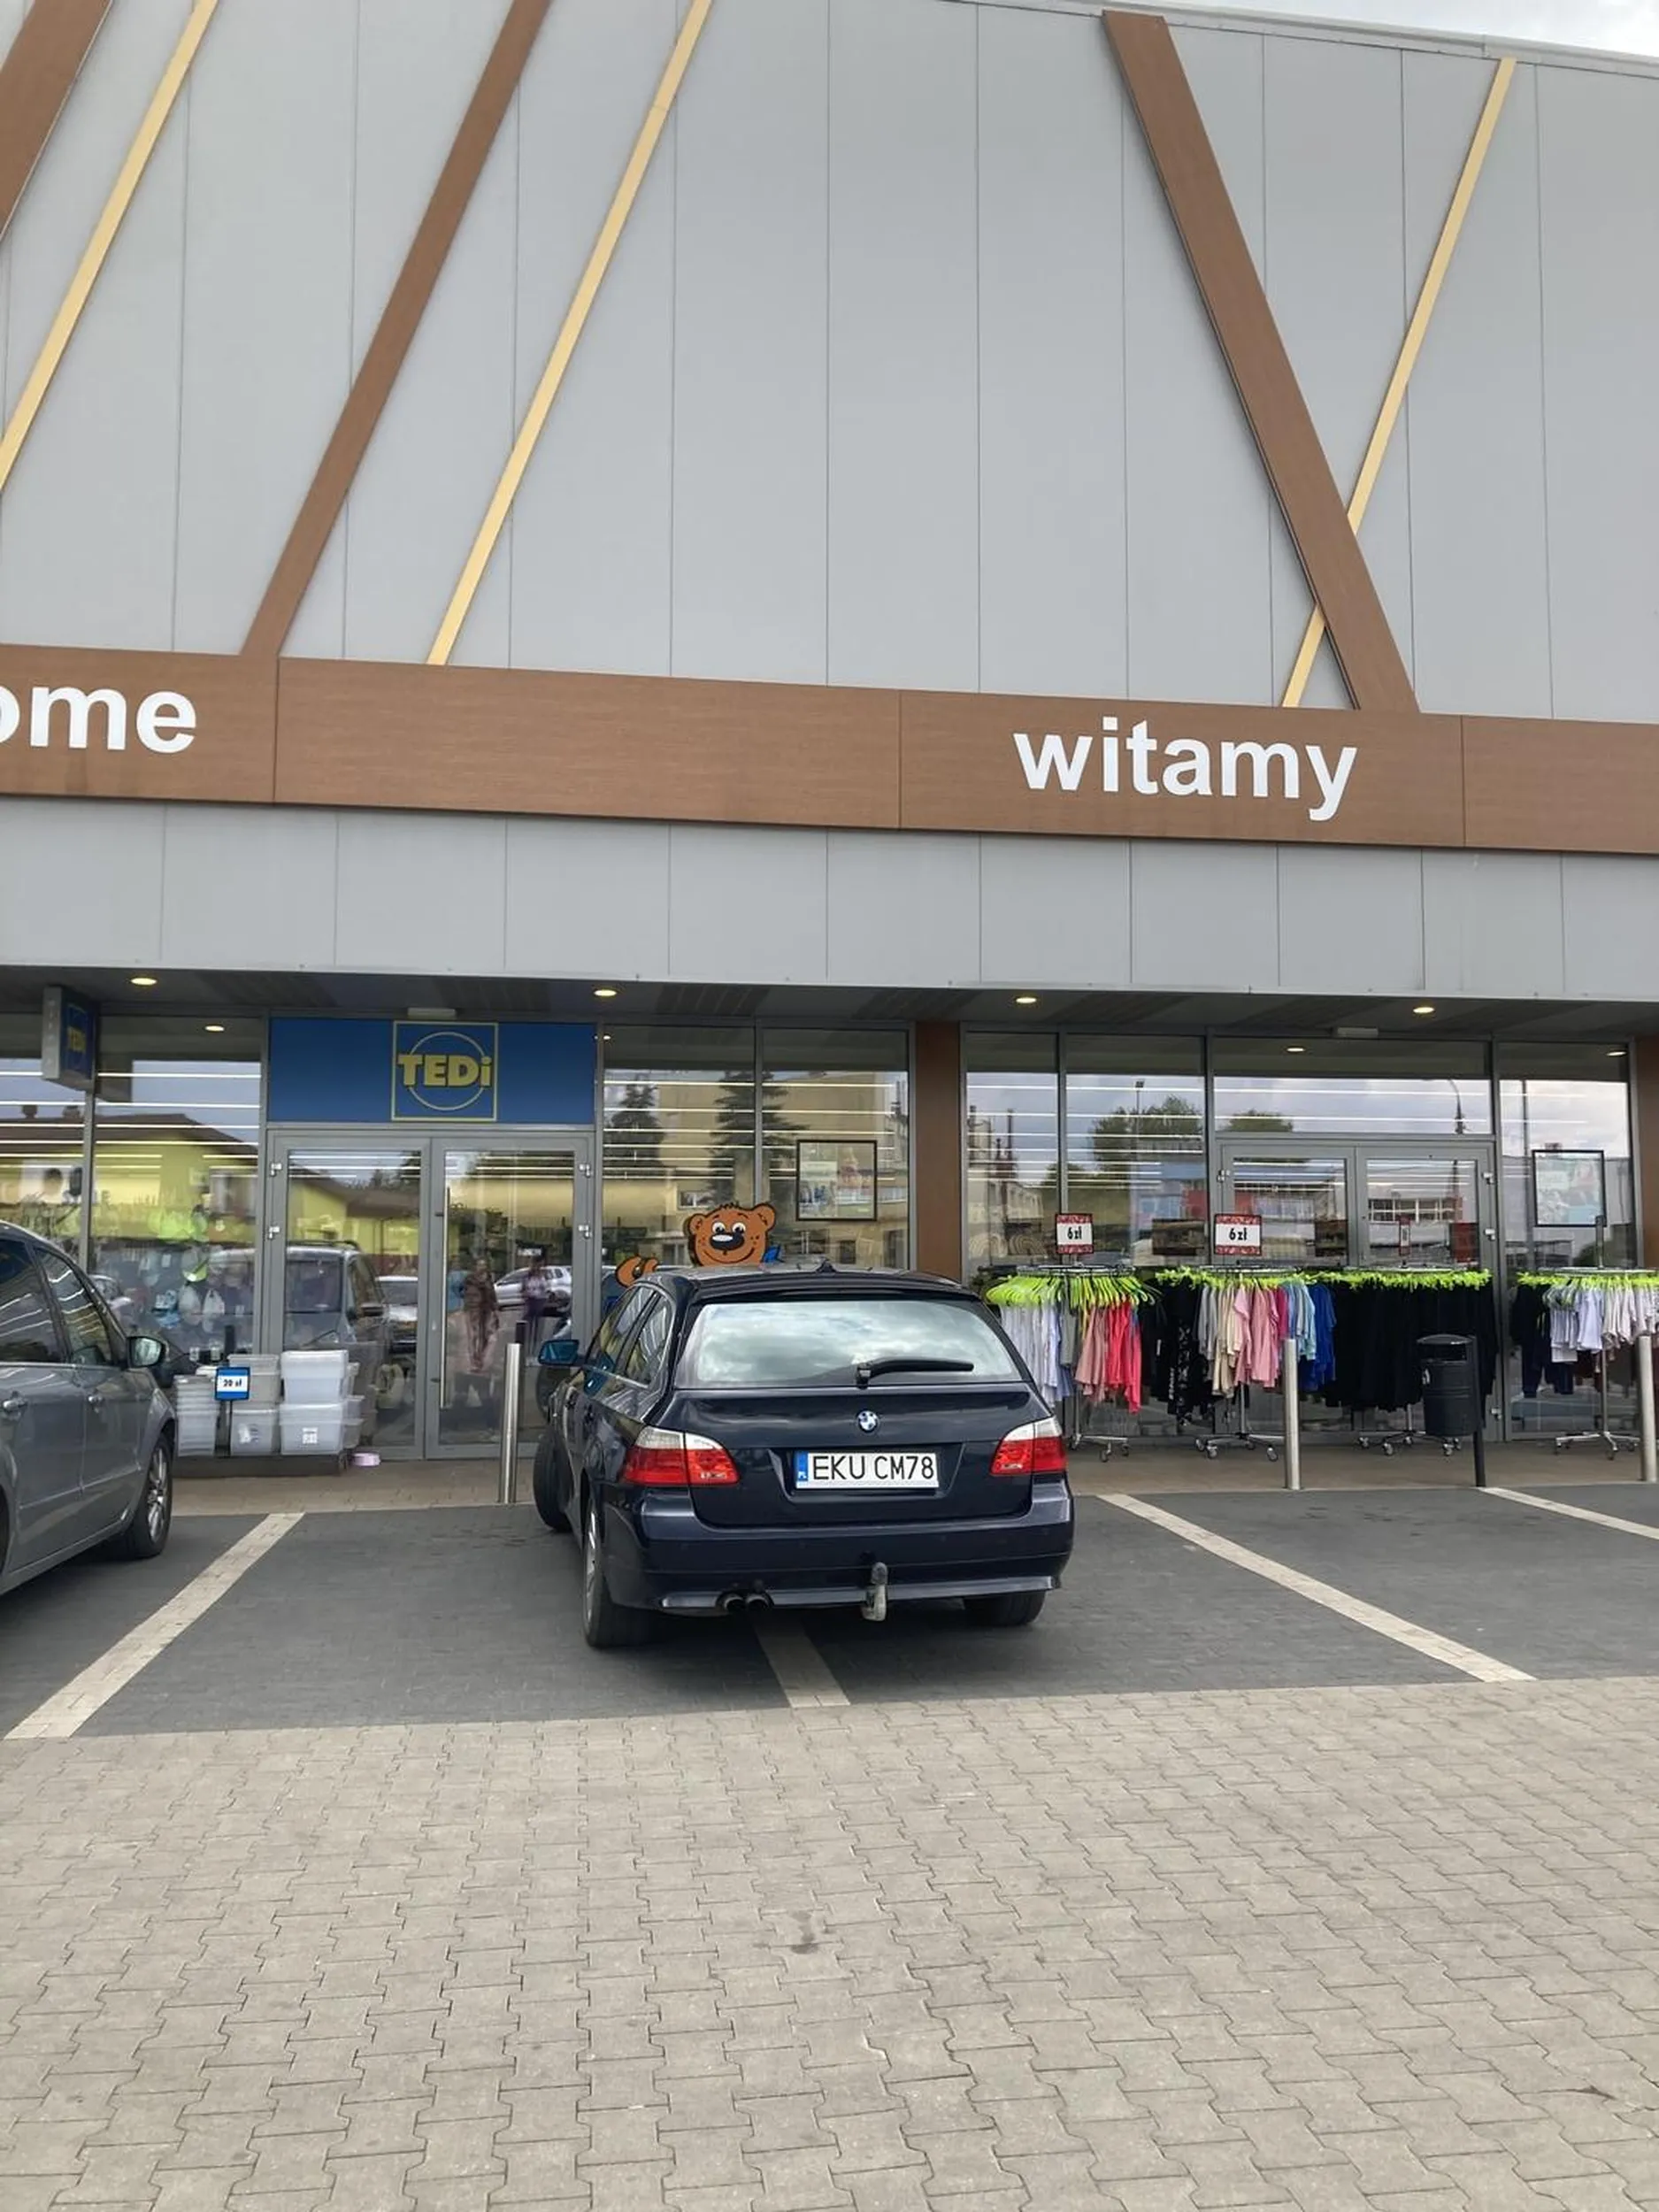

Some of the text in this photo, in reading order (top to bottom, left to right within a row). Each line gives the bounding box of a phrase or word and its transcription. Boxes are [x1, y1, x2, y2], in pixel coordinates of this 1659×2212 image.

[1012, 716, 1357, 822] witamy
[397, 1054, 493, 1087] TEDi
[1229, 1227, 1236, 1240] 6
[812, 1455, 934, 1480] EKU CM78
